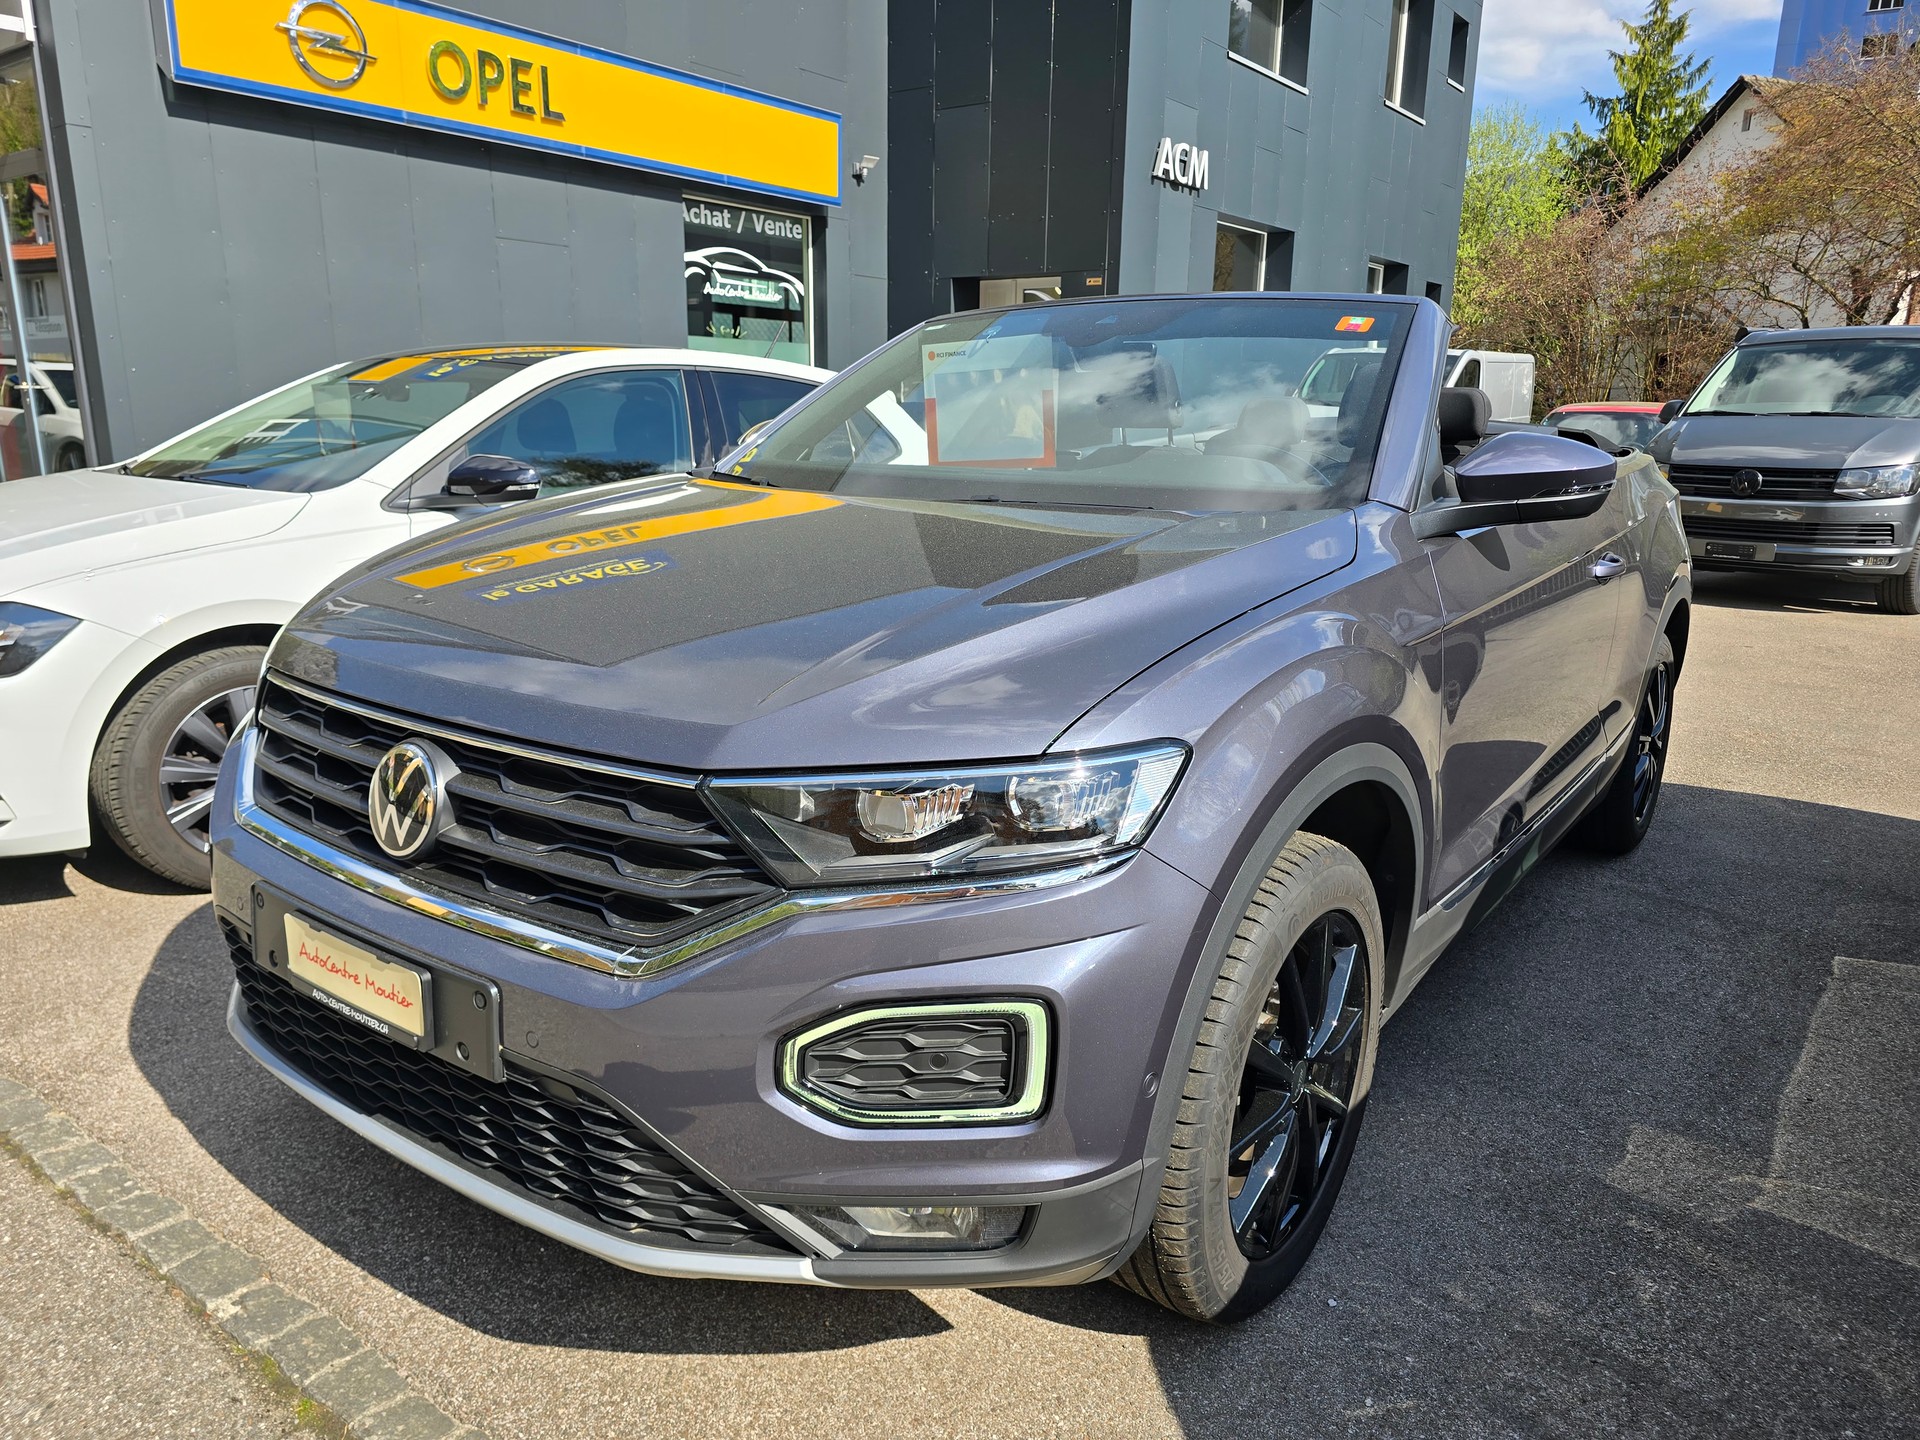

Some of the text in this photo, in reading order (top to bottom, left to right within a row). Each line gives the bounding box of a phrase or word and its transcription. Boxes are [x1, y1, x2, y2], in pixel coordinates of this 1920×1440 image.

[428, 40, 567, 122] OPEL
[1152, 136, 1209, 191] ACM
[682, 201, 732, 230] Achat
[751, 213, 803, 239] Vente
[945, 350, 967, 358] FINANCE
[299, 942, 414, 1009] AutoCentre Moutier
